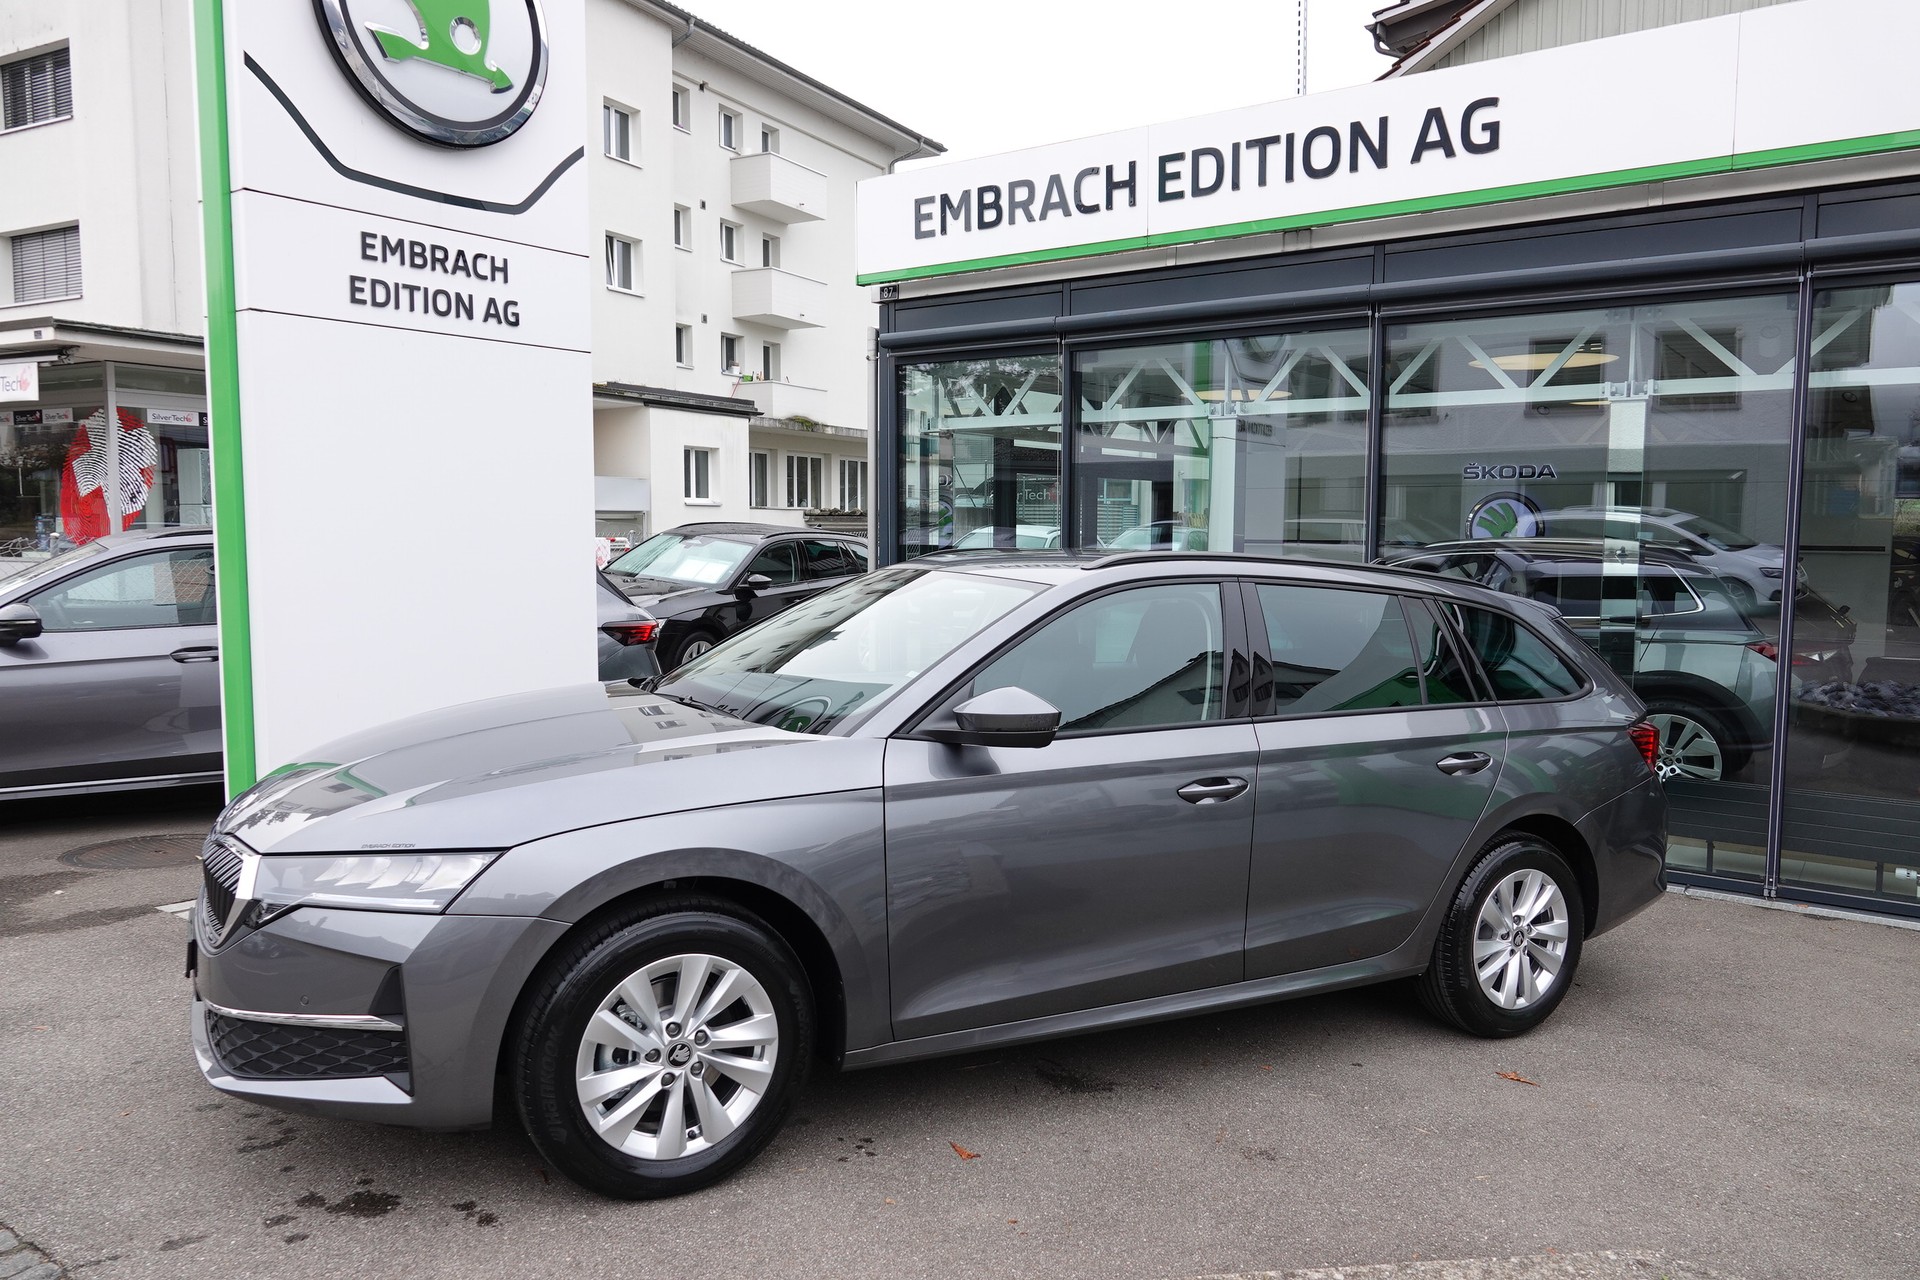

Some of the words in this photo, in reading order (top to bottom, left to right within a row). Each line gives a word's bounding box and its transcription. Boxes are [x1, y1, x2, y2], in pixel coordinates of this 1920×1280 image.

[913, 158, 1138, 241] EMBRACH
[1158, 114, 1390, 204] EDITION
[1410, 96, 1501, 165] AG
[360, 231, 509, 284] EMBRACH
[349, 274, 474, 321] EDITION
[482, 297, 520, 328] AG
[883, 287, 893, 298] 87
[1463, 462, 1558, 480] ŠKODA
